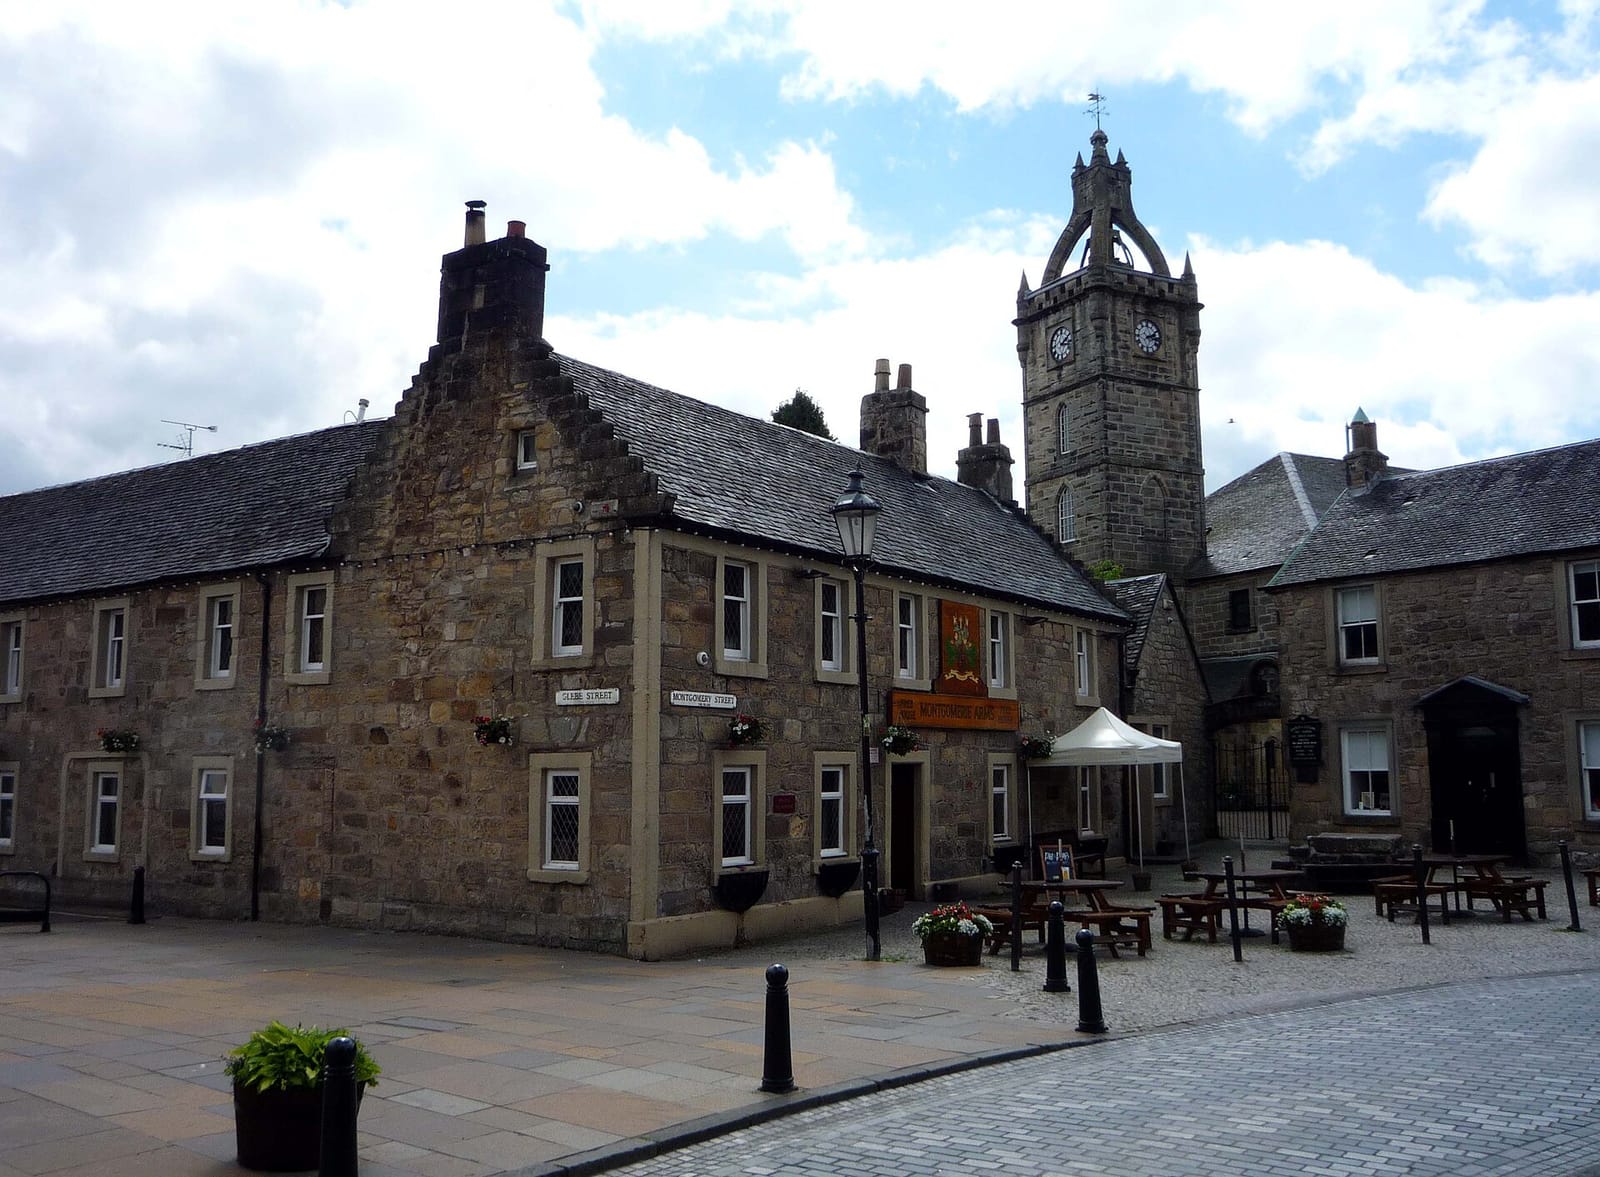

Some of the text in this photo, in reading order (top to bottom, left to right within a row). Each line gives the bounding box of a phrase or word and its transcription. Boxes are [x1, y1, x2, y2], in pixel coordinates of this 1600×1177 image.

[561, 691, 613, 701] GLEBE STREET
[672, 692, 712, 703] MONTGOMERY
[714, 695, 734, 705] STREET
[975, 705, 995, 720] ARMS
